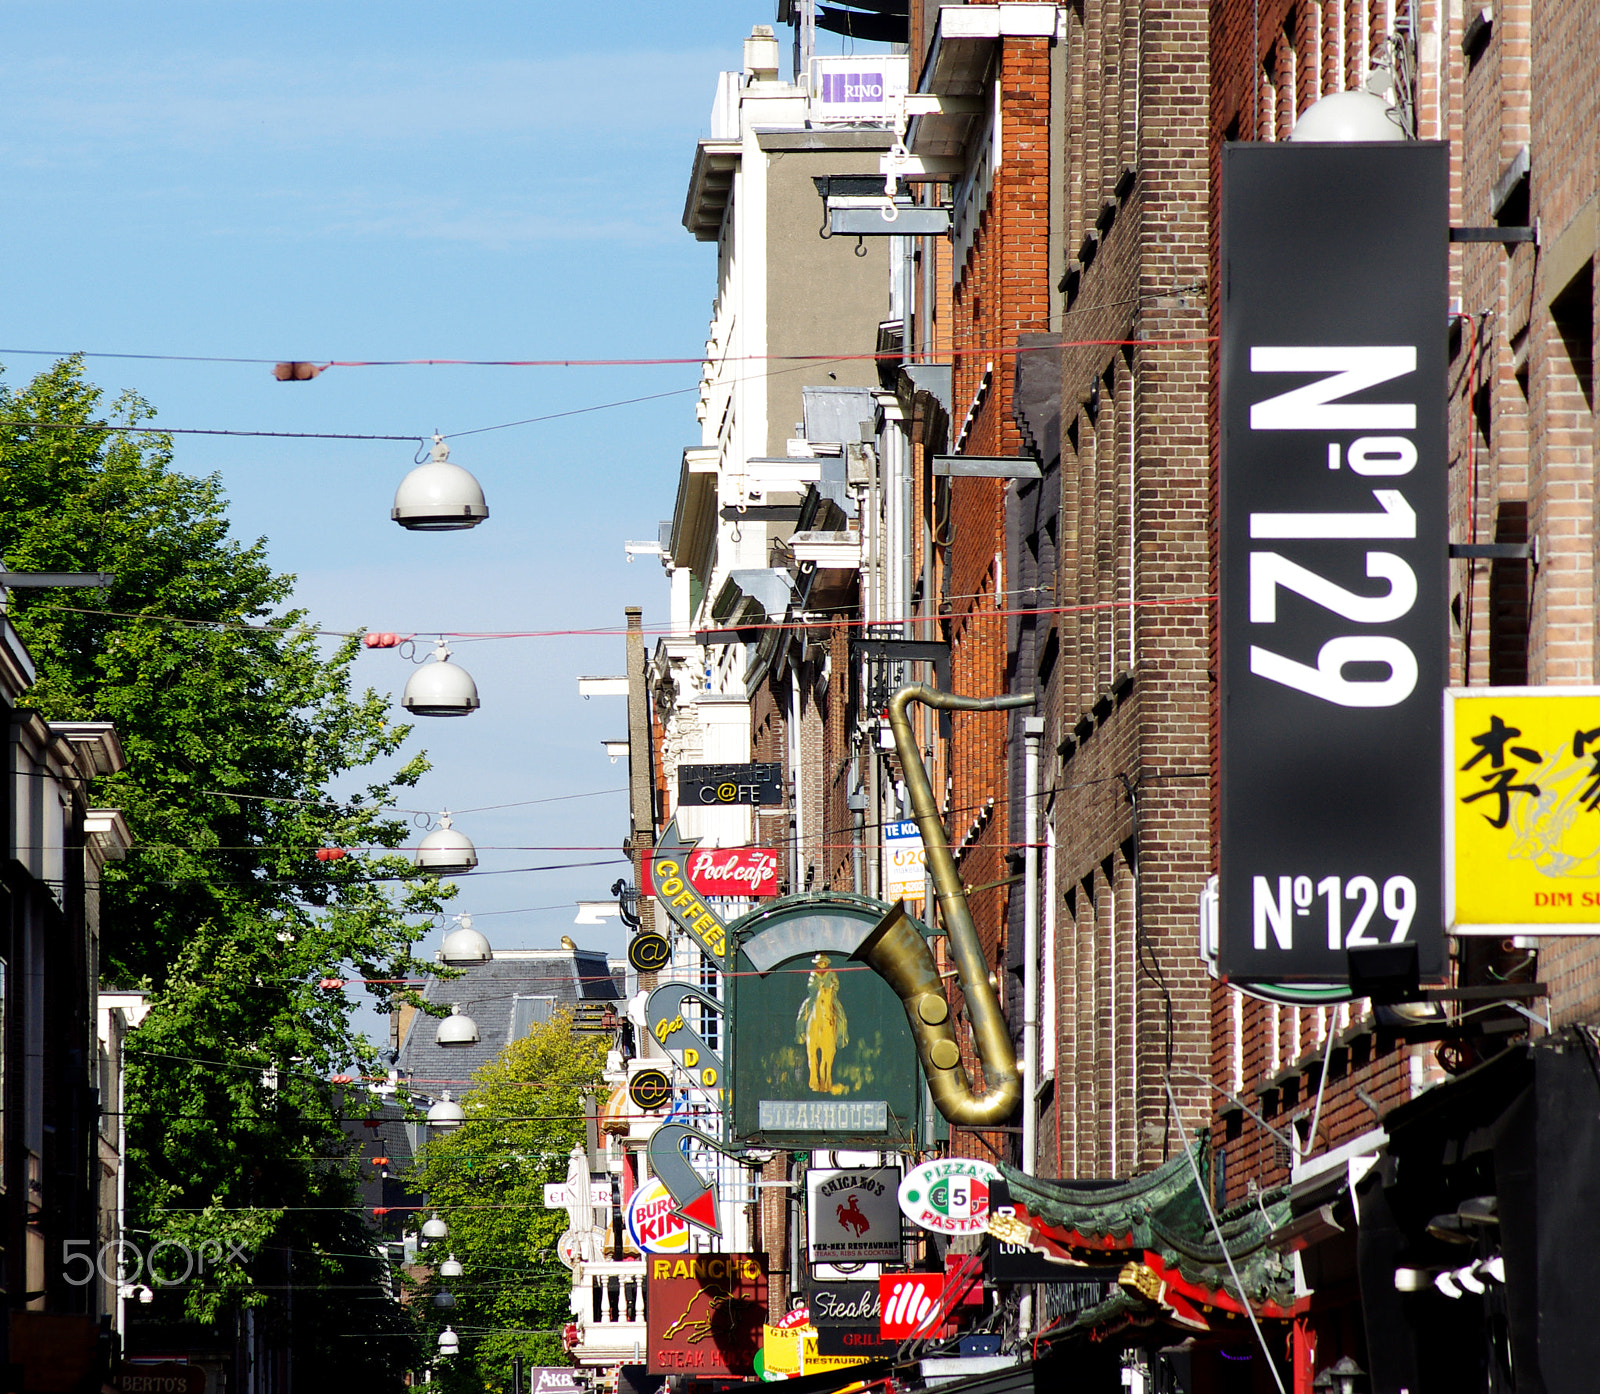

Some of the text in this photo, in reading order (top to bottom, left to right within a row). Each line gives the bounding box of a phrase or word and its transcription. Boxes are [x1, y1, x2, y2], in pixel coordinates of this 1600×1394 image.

[844, 84, 882, 98] RINO
[886, 824, 899, 837] TE
[1535, 892, 1573, 907] DIM
[655, 1014, 684, 1043] Get
[923, 1162, 995, 1183] PIZZA'S
[654, 1259, 761, 1280] RANCHO
[884, 1281, 941, 1333] illy
[657, 1349, 704, 1368] STEAK
